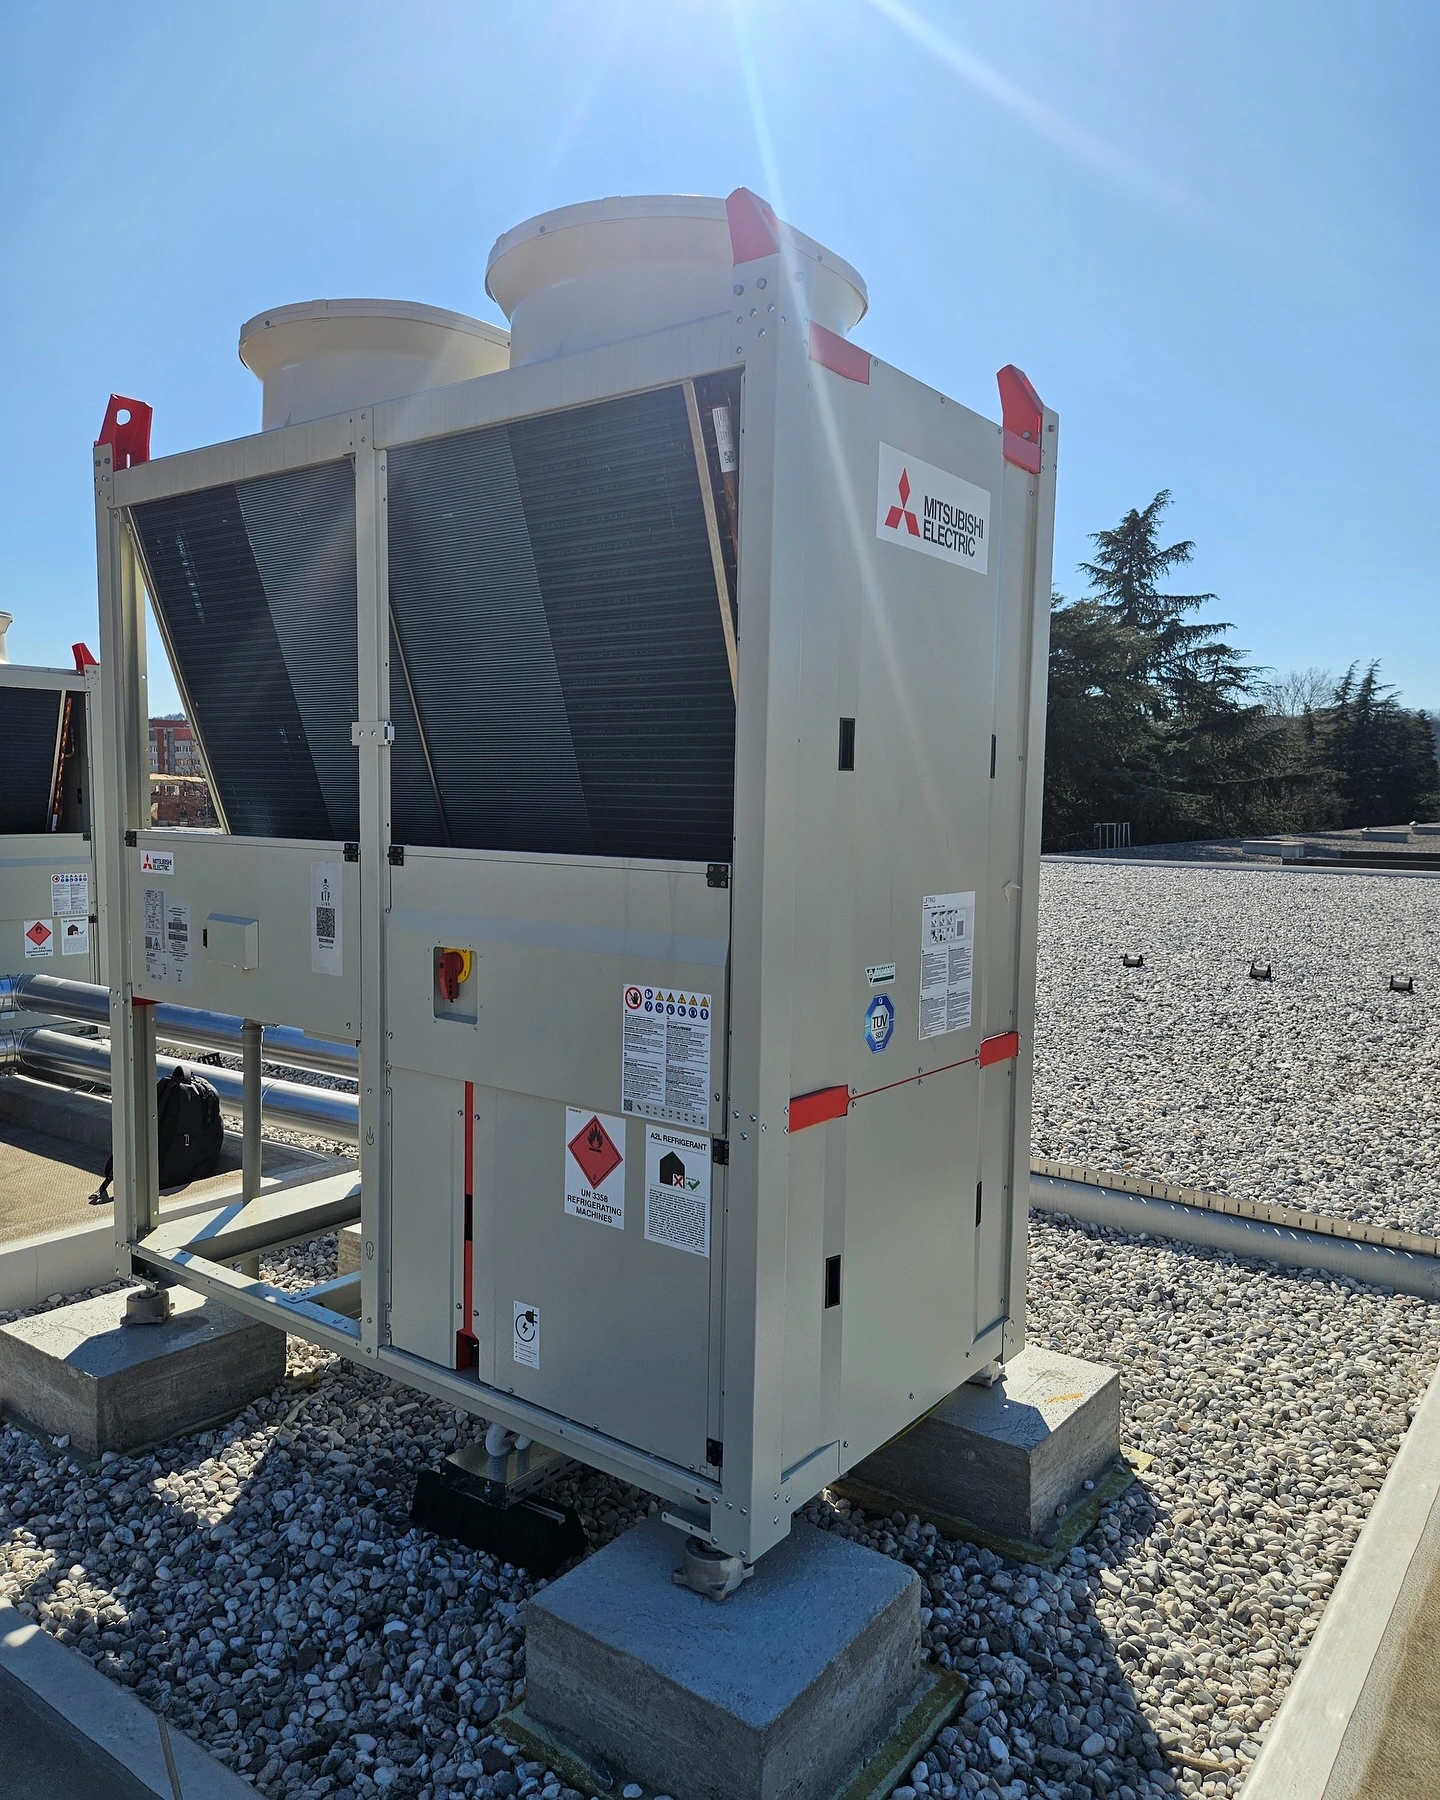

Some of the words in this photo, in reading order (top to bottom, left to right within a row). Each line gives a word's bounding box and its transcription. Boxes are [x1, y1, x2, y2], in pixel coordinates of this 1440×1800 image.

[924, 495, 984, 539] MITSUBISHI
[923, 519, 976, 557] ELECTRIC
[872, 1013, 888, 1029] TÜV
[650, 1132, 662, 1141] A2L
[663, 1135, 707, 1151] REFRIGERANT
[567, 1194, 622, 1217] REFRIGERATING
[581, 1189, 592, 1198] UN
[592, 1191, 609, 1203] 3358
[575, 1206, 613, 1224] MACHINES
